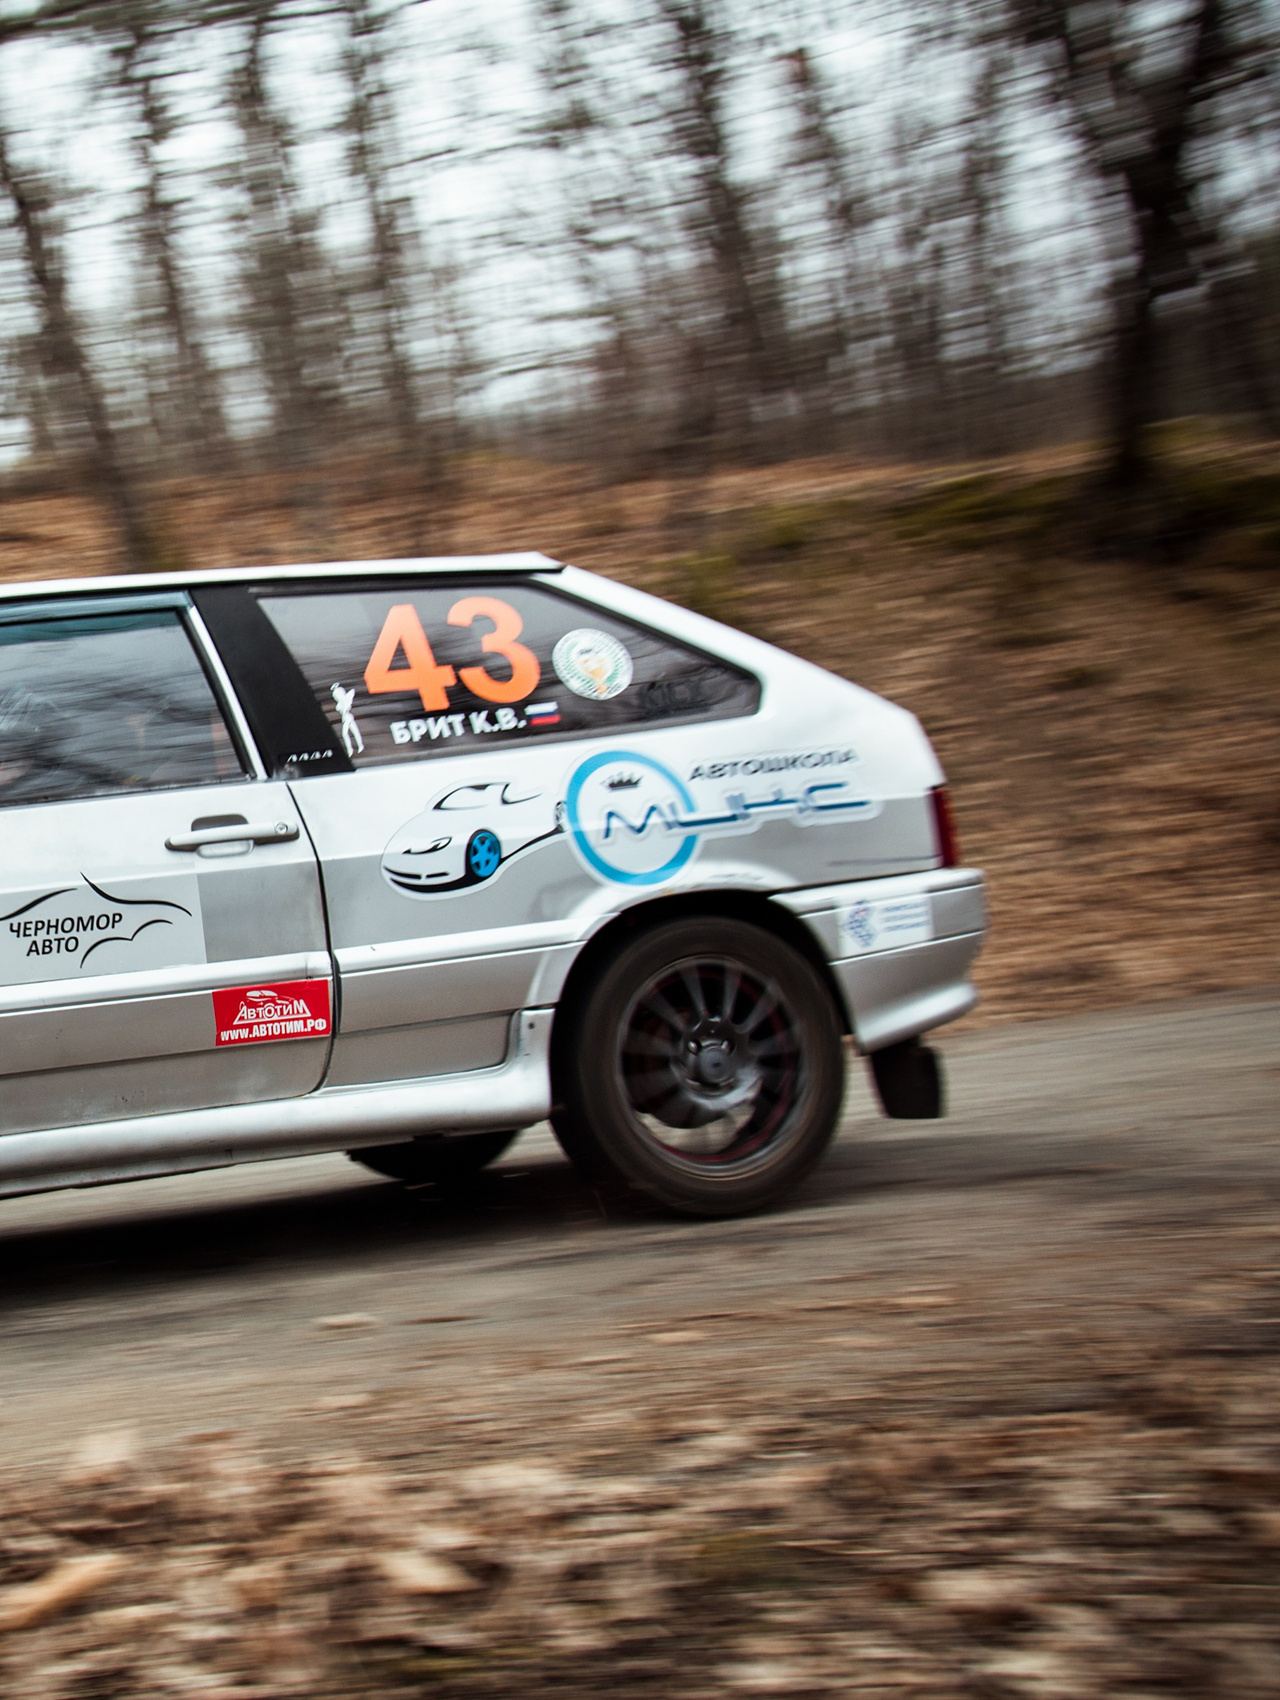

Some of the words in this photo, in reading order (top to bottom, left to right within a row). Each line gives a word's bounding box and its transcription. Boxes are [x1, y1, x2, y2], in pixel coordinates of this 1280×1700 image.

[363, 596, 541, 712] 43
[390, 713, 466, 745] БРИТ
[469, 707, 528, 735] К.В.
[687, 749, 859, 781] АВТОШКОЛА
[9, 912, 123, 938] ЧЕРНОМОР
[26, 936, 79, 956] АВТО
